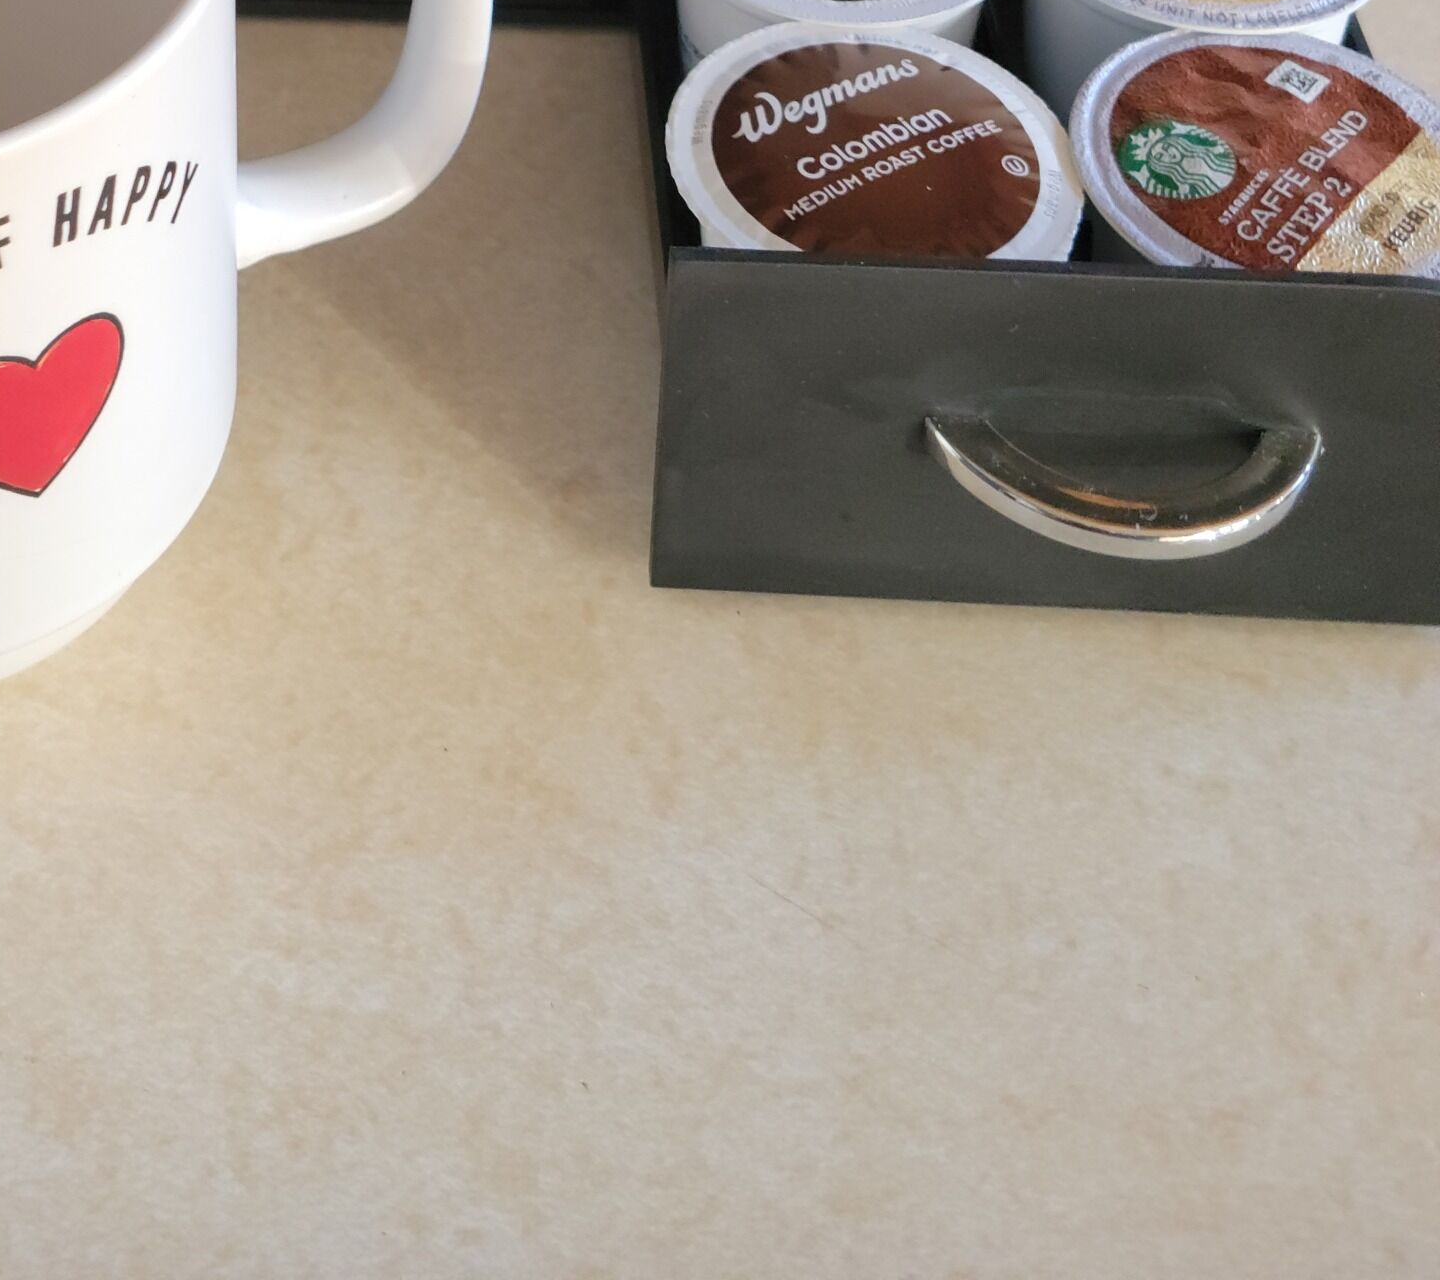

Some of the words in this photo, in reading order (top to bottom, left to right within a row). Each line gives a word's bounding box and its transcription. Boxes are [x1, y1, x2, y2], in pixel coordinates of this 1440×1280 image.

[1154, 1, 1195, 20] UNIT
[1203, 10, 1238, 26] NOT
[732, 58, 920, 143] Wegmans
[783, 174, 863, 221] MEDIUM
[861, 145, 926, 182] ROAST
[926, 119, 1003, 153] COFFEE
[796, 108, 953, 179] Colombian
[1297, 110, 1368, 172] BLEND
[52, 160, 198, 248] HAPPY
[1218, 167, 1270, 225] STARBUCKS
[1266, 191, 1334, 264] STEP
[1323, 176, 1352, 198] 2
